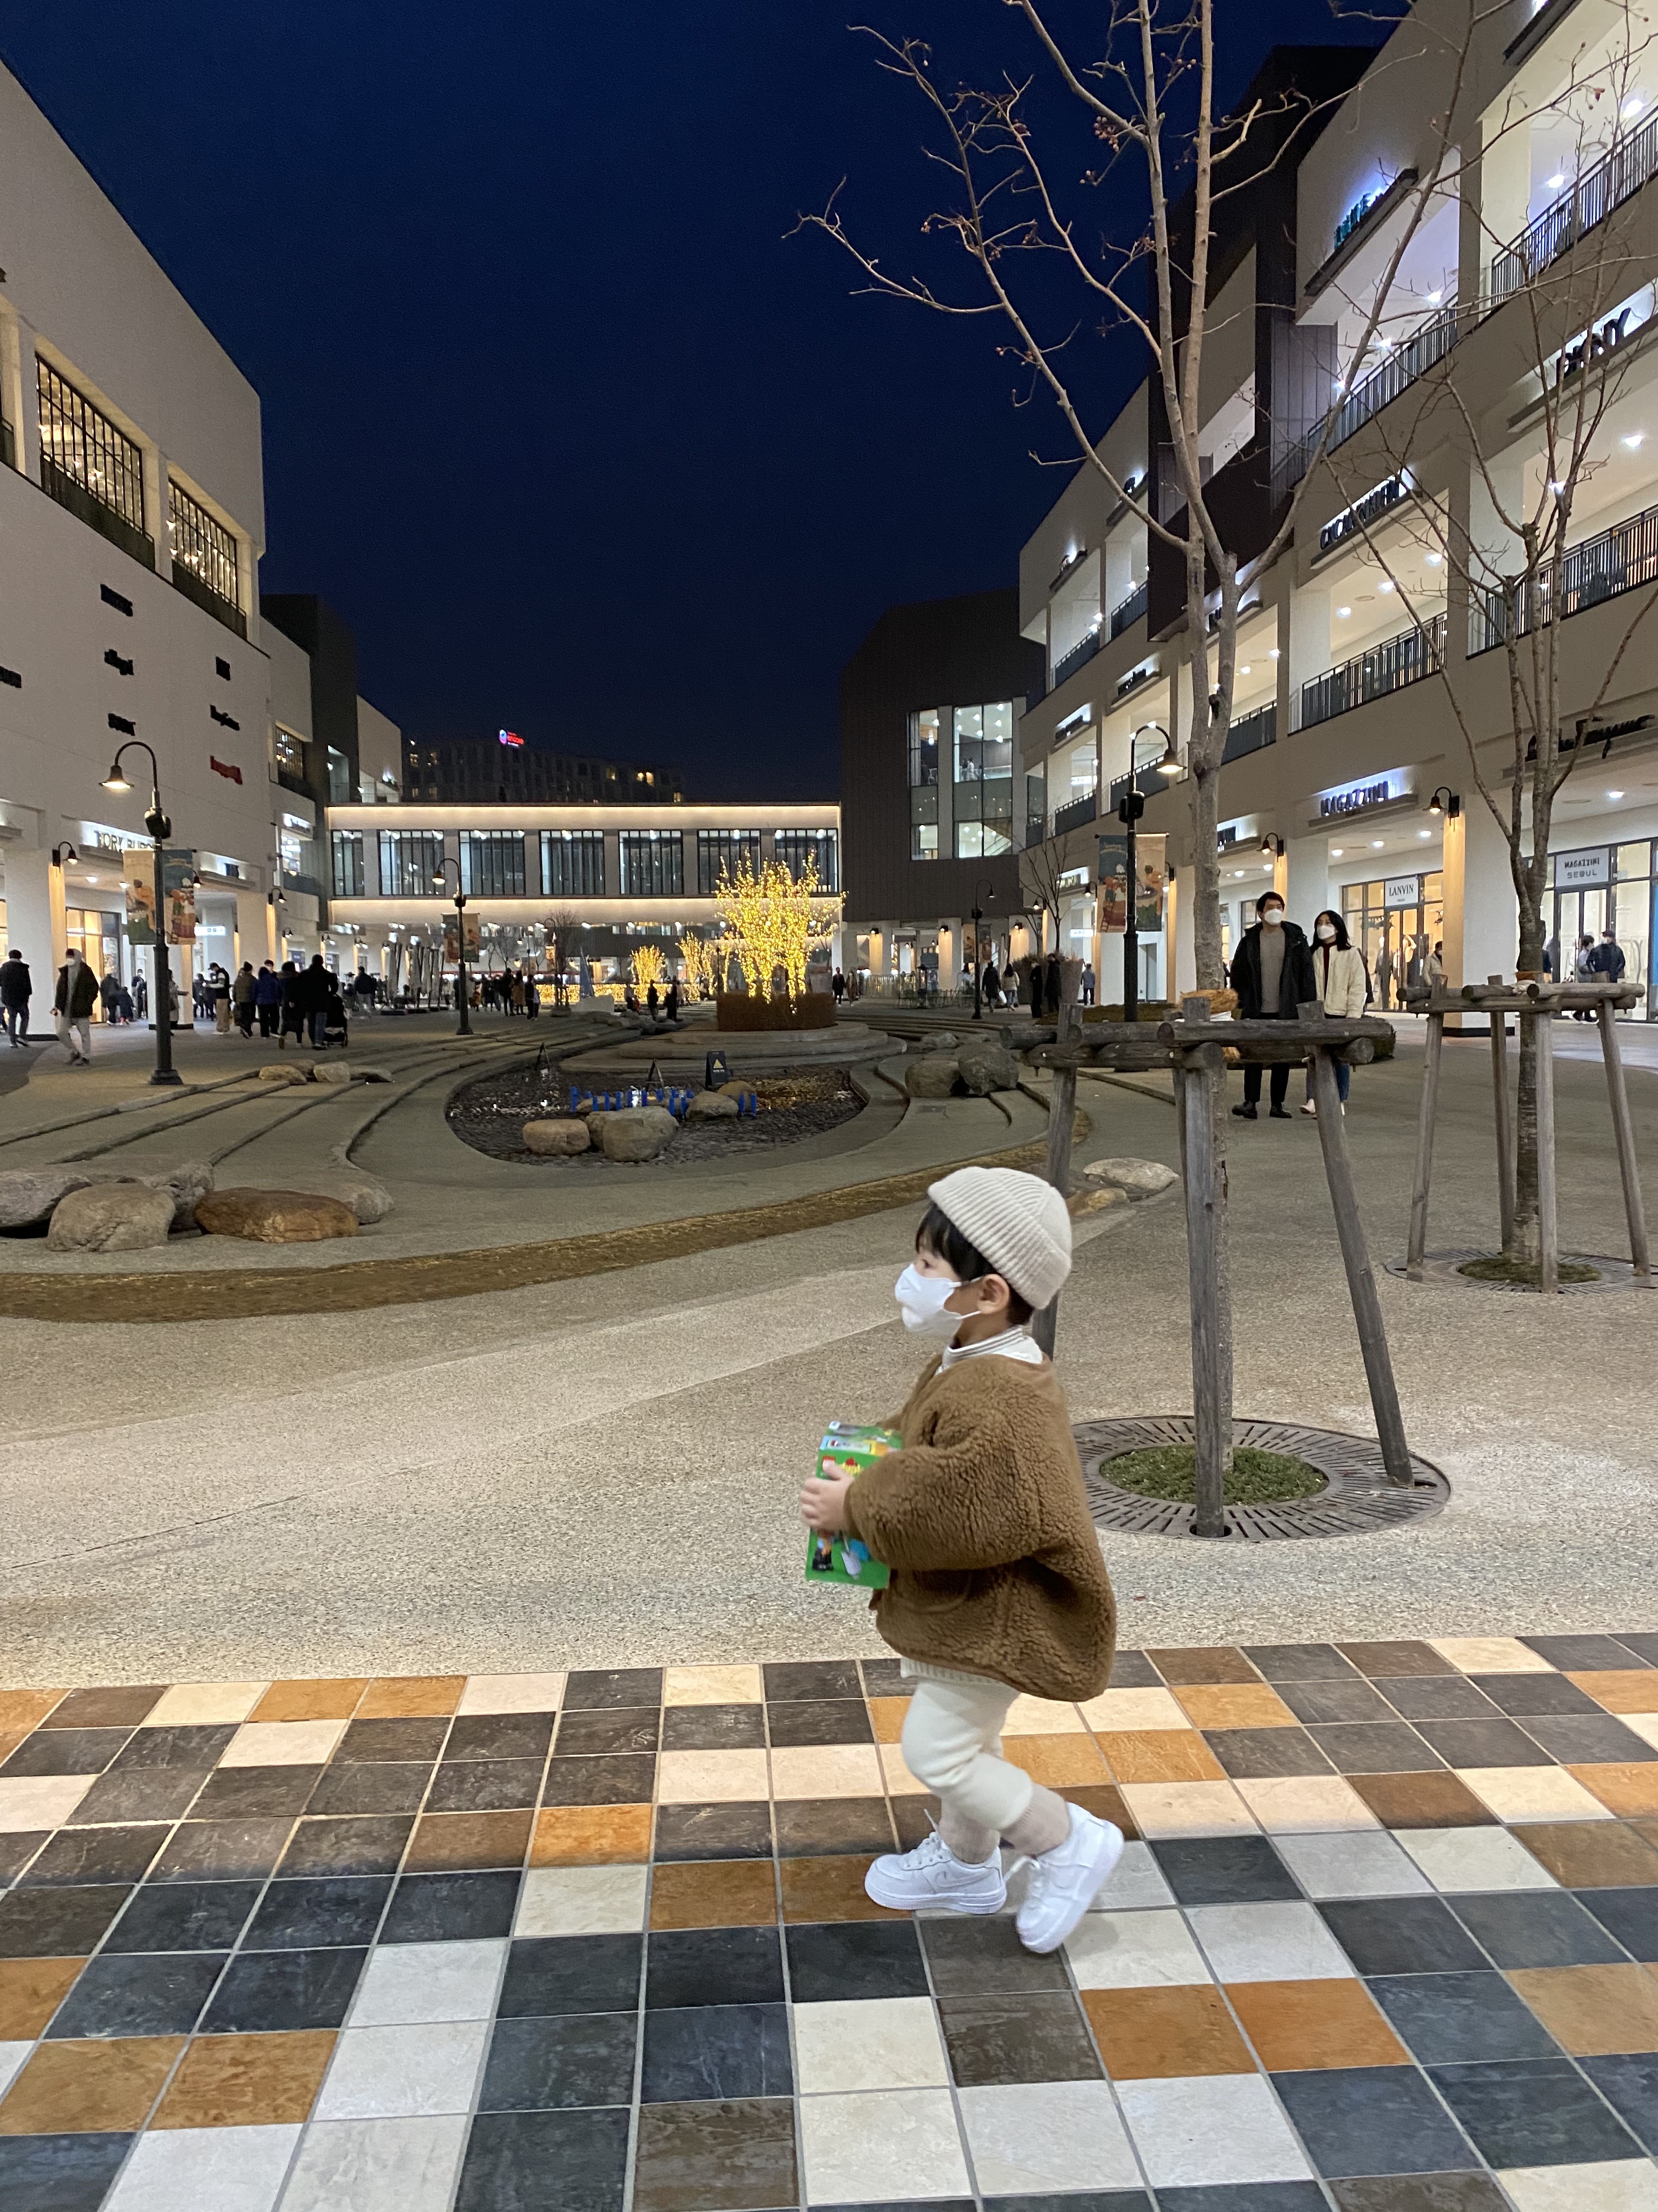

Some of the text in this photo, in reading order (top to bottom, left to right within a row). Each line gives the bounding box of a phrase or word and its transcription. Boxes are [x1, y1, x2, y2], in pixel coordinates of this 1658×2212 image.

[1564, 857, 1599, 868] MAGAZZINI
[1567, 870, 1597, 878] SEOUL
[1389, 884, 1414, 896] LANVIN
